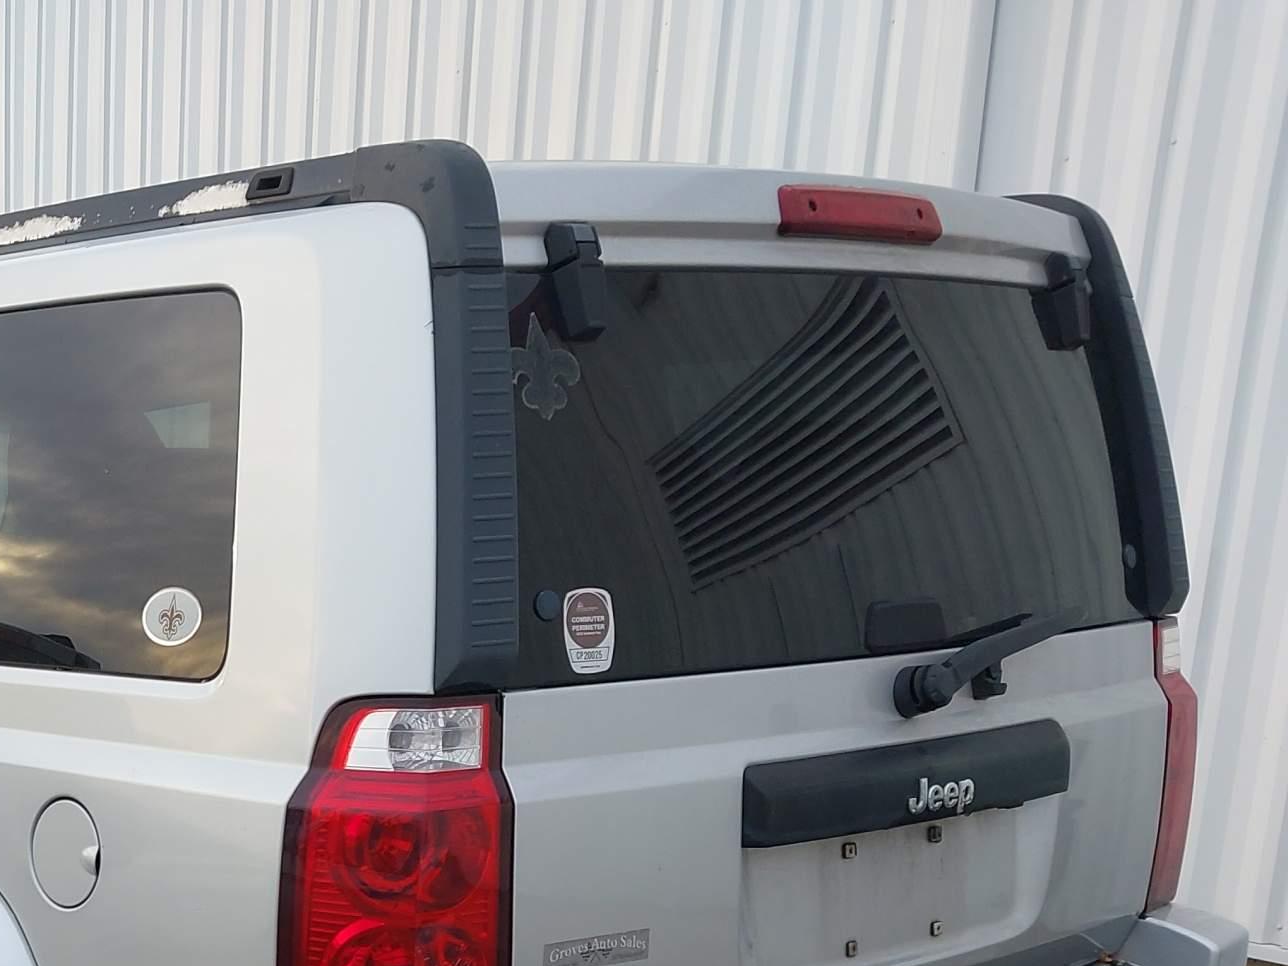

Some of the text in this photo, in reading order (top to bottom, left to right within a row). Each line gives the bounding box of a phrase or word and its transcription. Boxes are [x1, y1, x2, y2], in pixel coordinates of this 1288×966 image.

[908, 777, 974, 815] Jeep
[549, 935, 647, 962] Groves Auto Sales
